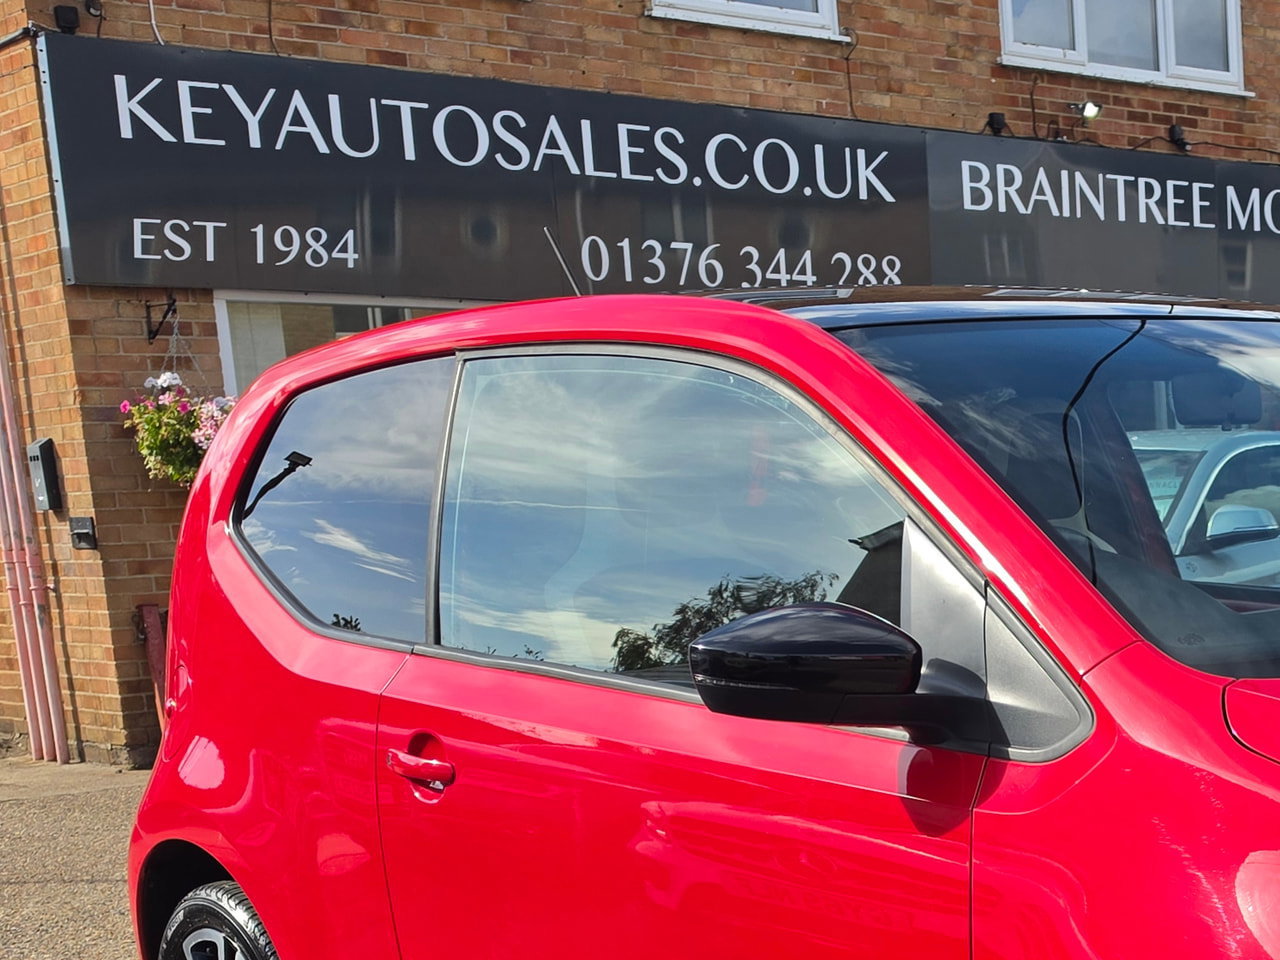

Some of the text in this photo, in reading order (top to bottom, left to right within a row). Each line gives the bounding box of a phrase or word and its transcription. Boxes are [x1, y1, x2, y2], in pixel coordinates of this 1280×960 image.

[112, 74, 897, 204] KEYAUTOSALES.CO.UK
[961, 160, 1217, 230] BRAINTREE
[133, 218, 359, 269] EST 1984
[581, 235, 902, 288] 01376 344 288
